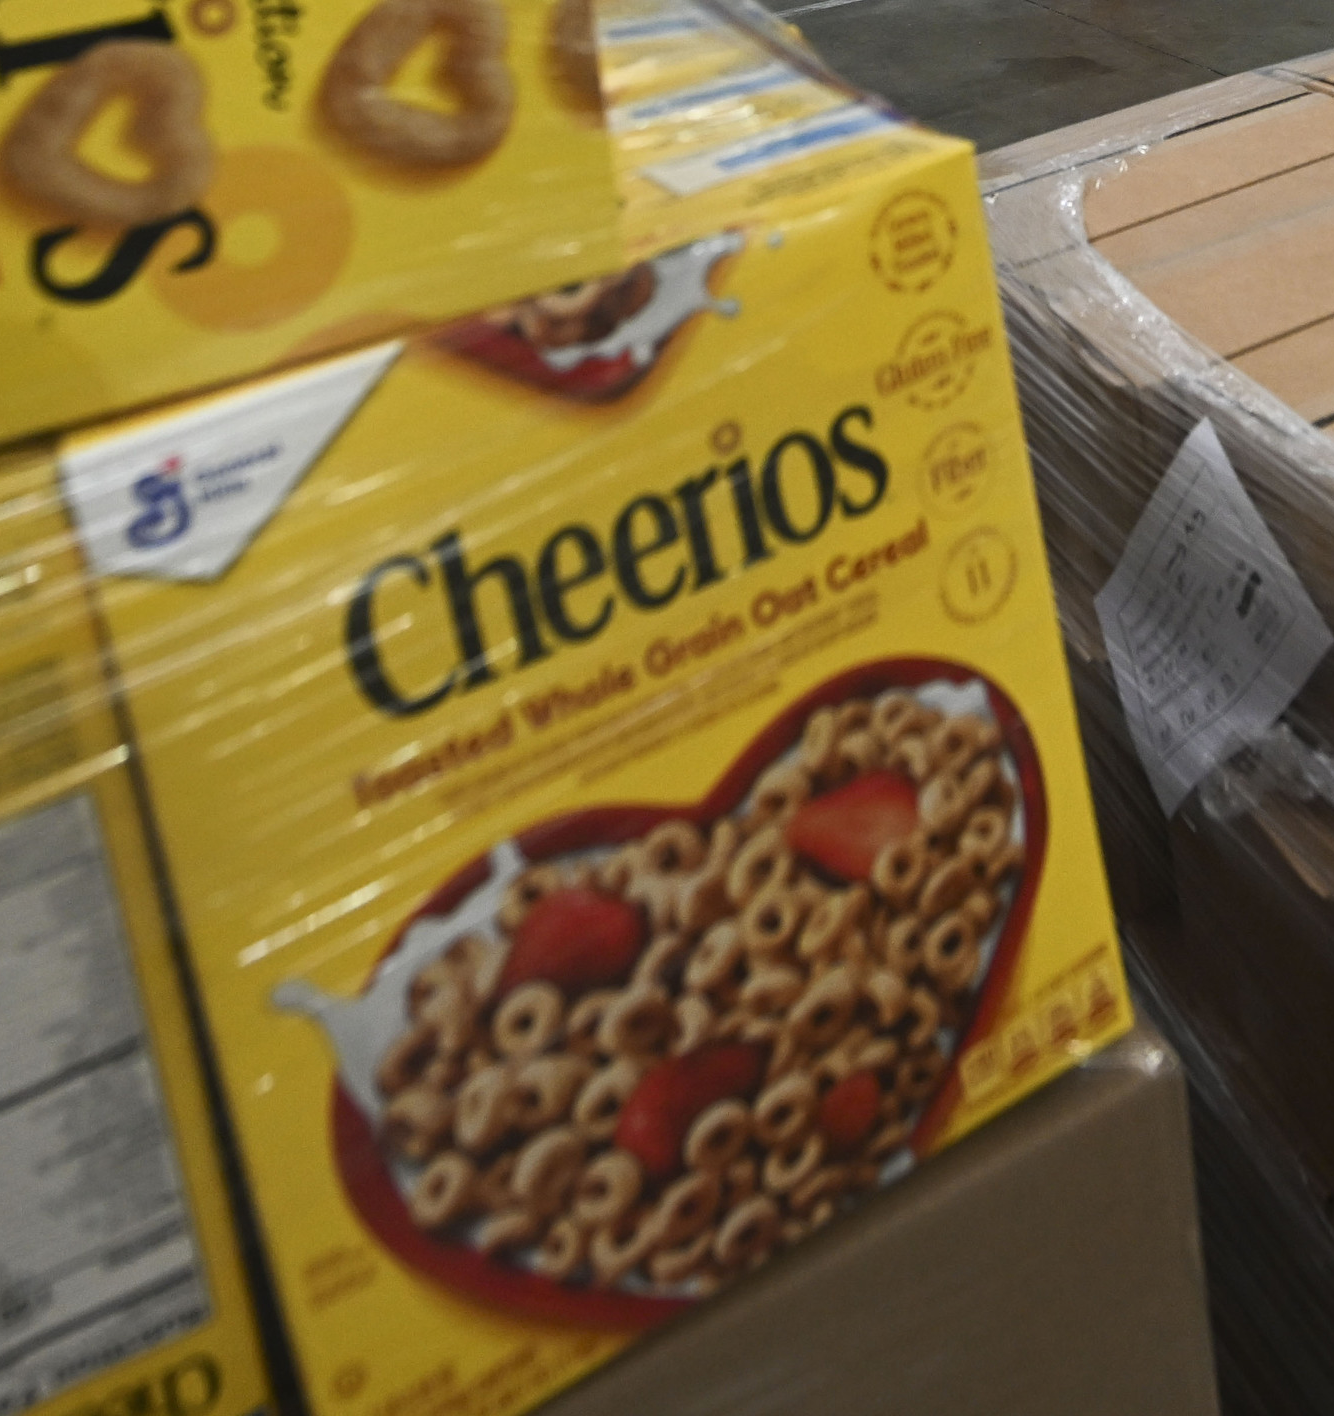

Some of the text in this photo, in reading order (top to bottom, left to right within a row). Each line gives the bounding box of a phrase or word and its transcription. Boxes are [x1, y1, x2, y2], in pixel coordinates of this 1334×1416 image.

[341, 403, 891, 721] Cheerios
[522, 663, 634, 730] Whole
[643, 615, 746, 677] Grain
[750, 573, 820, 627] Oat
[824, 516, 930, 594] Cereal
